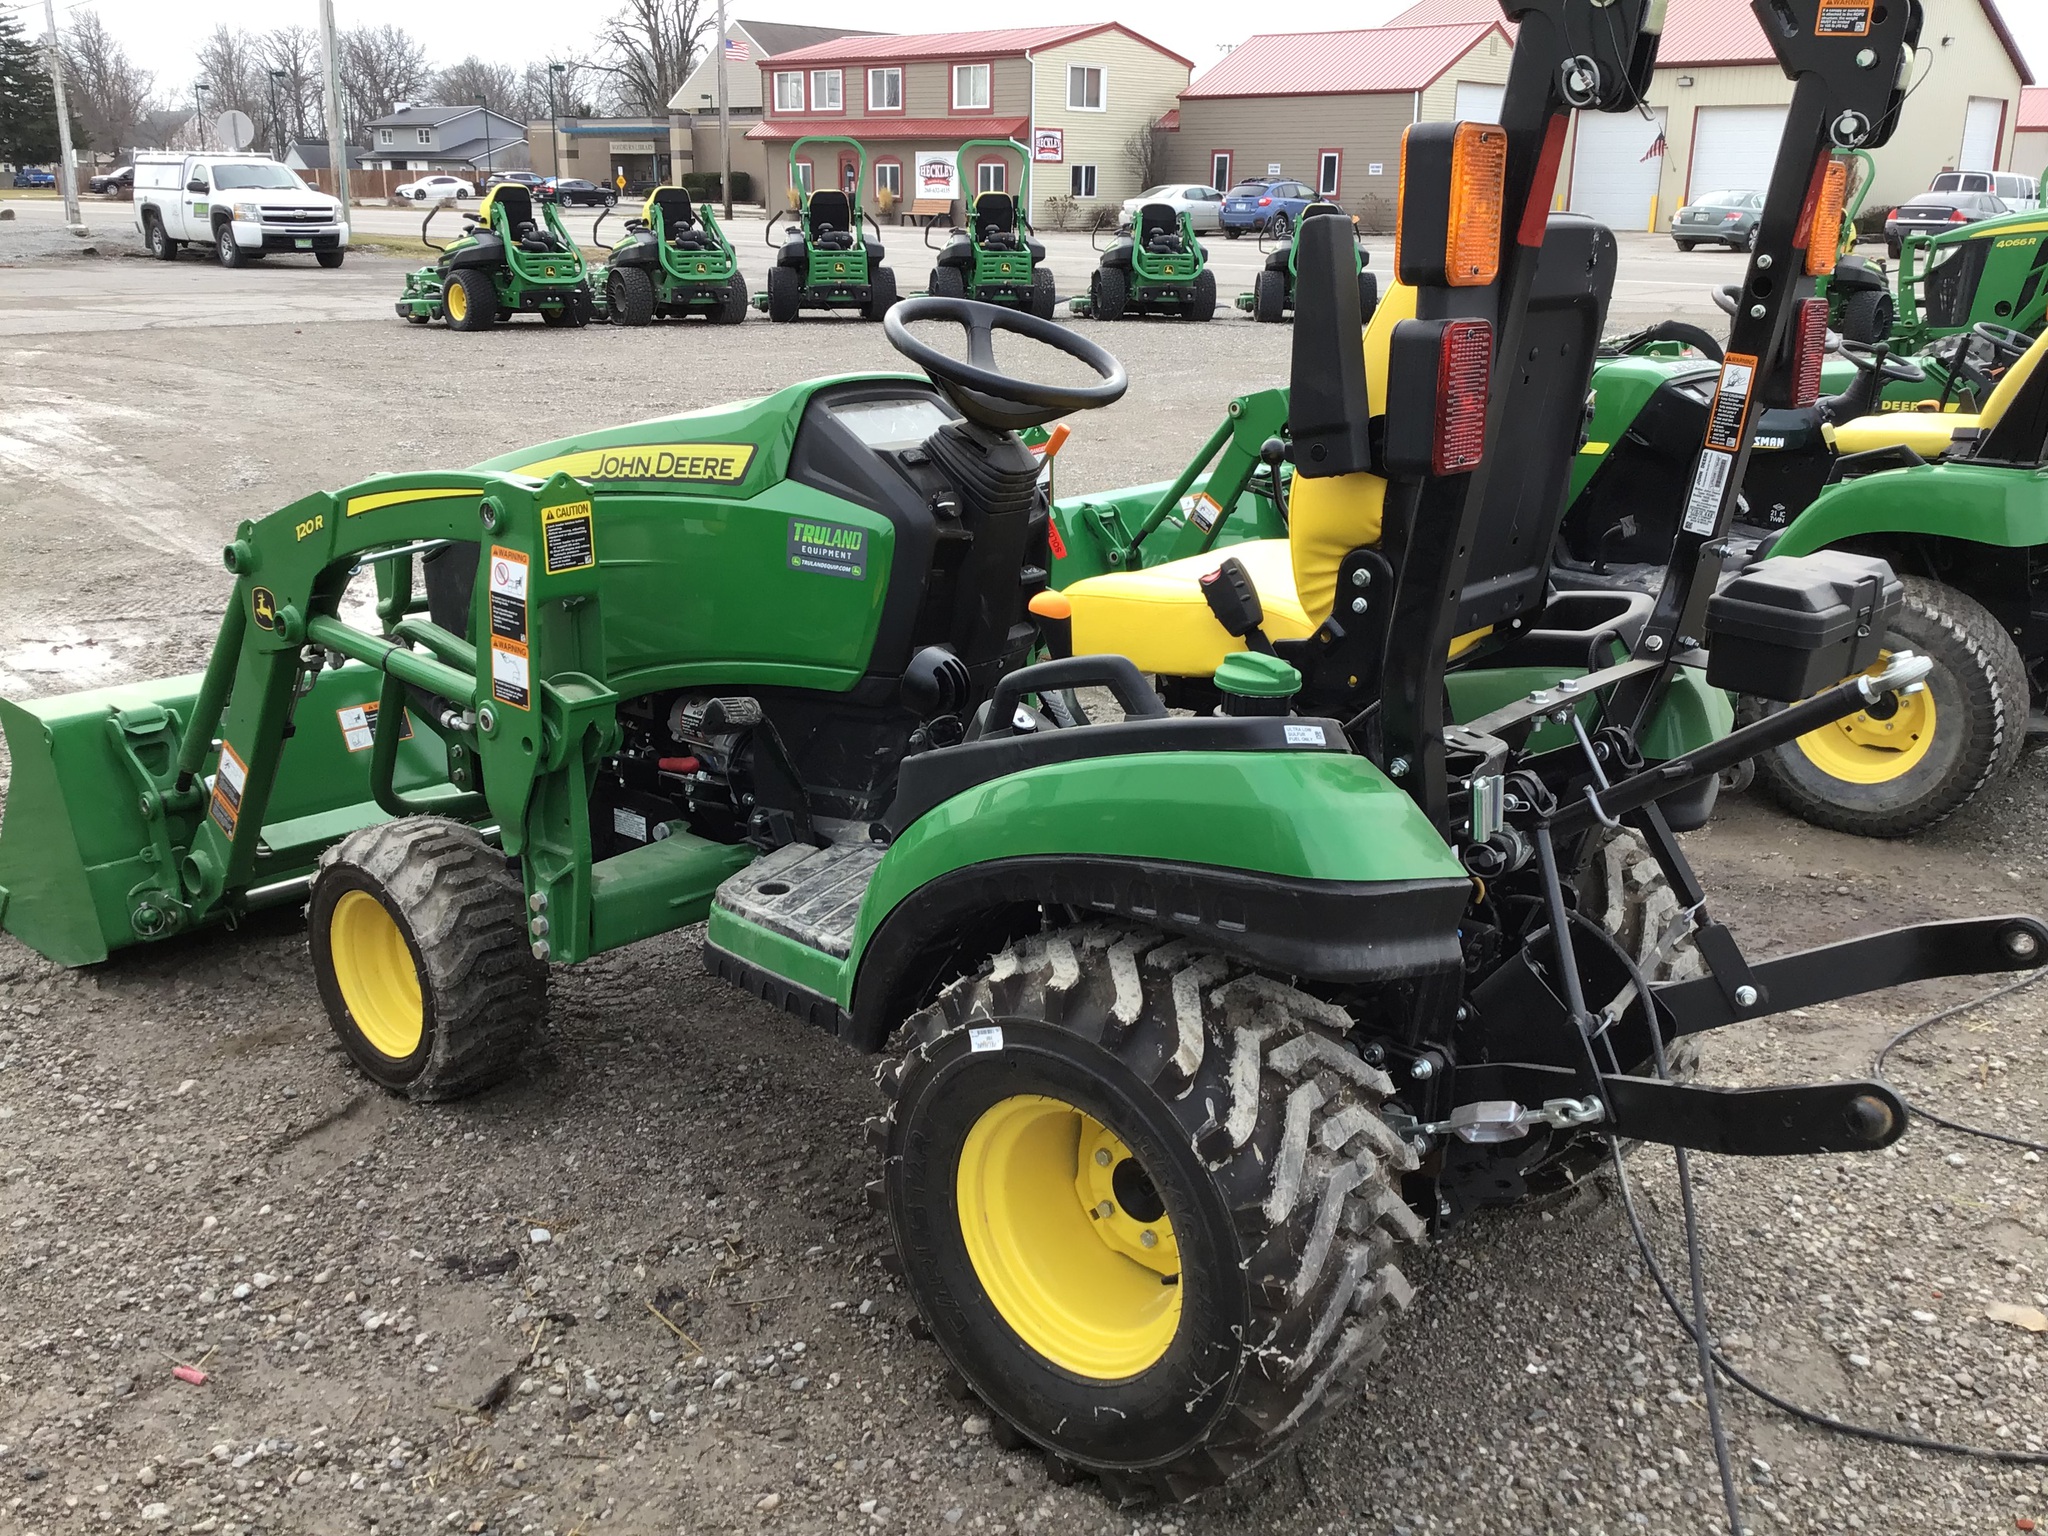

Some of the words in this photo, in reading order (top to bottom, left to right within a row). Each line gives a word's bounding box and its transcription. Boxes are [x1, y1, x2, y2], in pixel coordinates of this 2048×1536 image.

[1036, 138, 1061, 148] HECKLEY
[920, 164, 954, 178] HECKLEY
[1881, 400, 1919, 411] DEER
[1753, 436, 1785, 448] SMAN
[590, 453, 652, 476] JOHN
[655, 452, 735, 477] DEERE
[555, 503, 589, 518] CAUTION
[794, 522, 862, 550] TRULAND
[499, 549, 527, 563] WARNING
[801, 545, 852, 559] EQUIPMENT
[801, 559, 851, 573] TRULANDEQUIP.COM
[499, 642, 527, 656] WARNING
